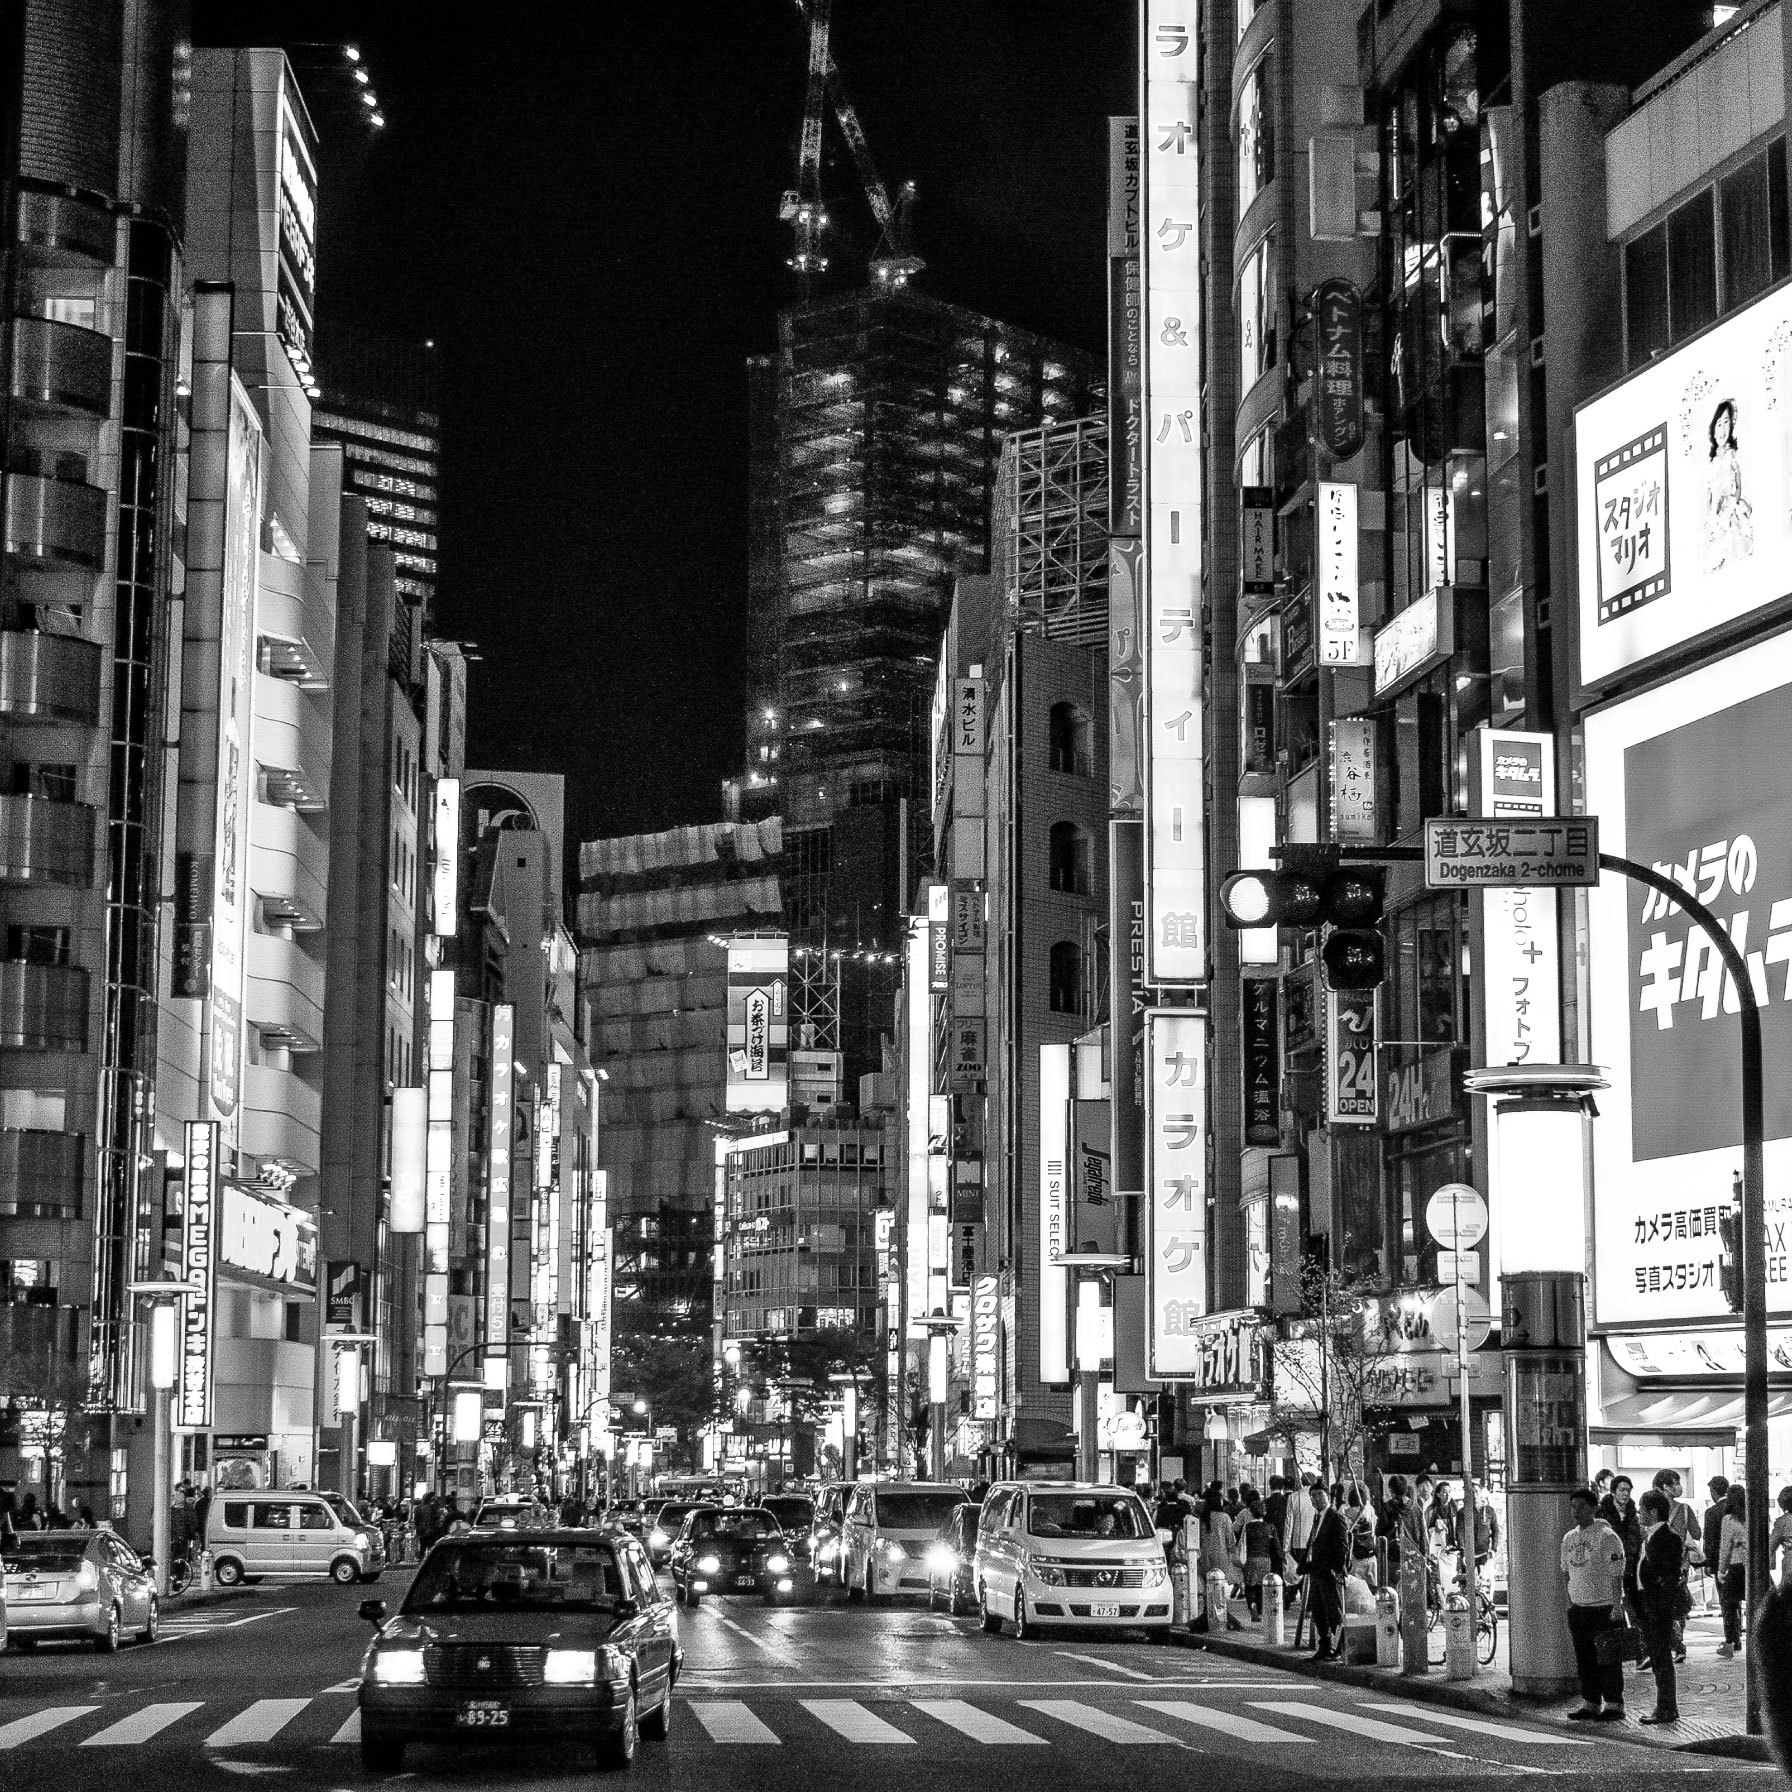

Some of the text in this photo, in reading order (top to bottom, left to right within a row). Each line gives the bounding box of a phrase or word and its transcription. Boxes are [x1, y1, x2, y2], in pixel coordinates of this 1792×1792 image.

[1603, 479, 1661, 533] スタジオ
[1610, 522, 1652, 576] マリオ
[1328, 640, 1354, 660] 5F
[1434, 827, 1589, 859] 道玄坂二丁目
[1439, 861, 1586, 882] Dogenzaka 2-chome
[1641, 834, 1758, 925] カメラの
[935, 927, 947, 976] PROMISE
[751, 999, 765, 1072] お茶づけ海苔
[960, 1031, 978, 1062] 麻雀
[1338, 1051, 1374, 1098] 24
[1339, 1099, 1375, 1113] OPEN
[1162, 1052, 1200, 1336] カラオケ館
[1049, 1180, 1060, 1257] SUIT SELEC
[1635, 1261, 1715, 1294] 写真スタジオ
